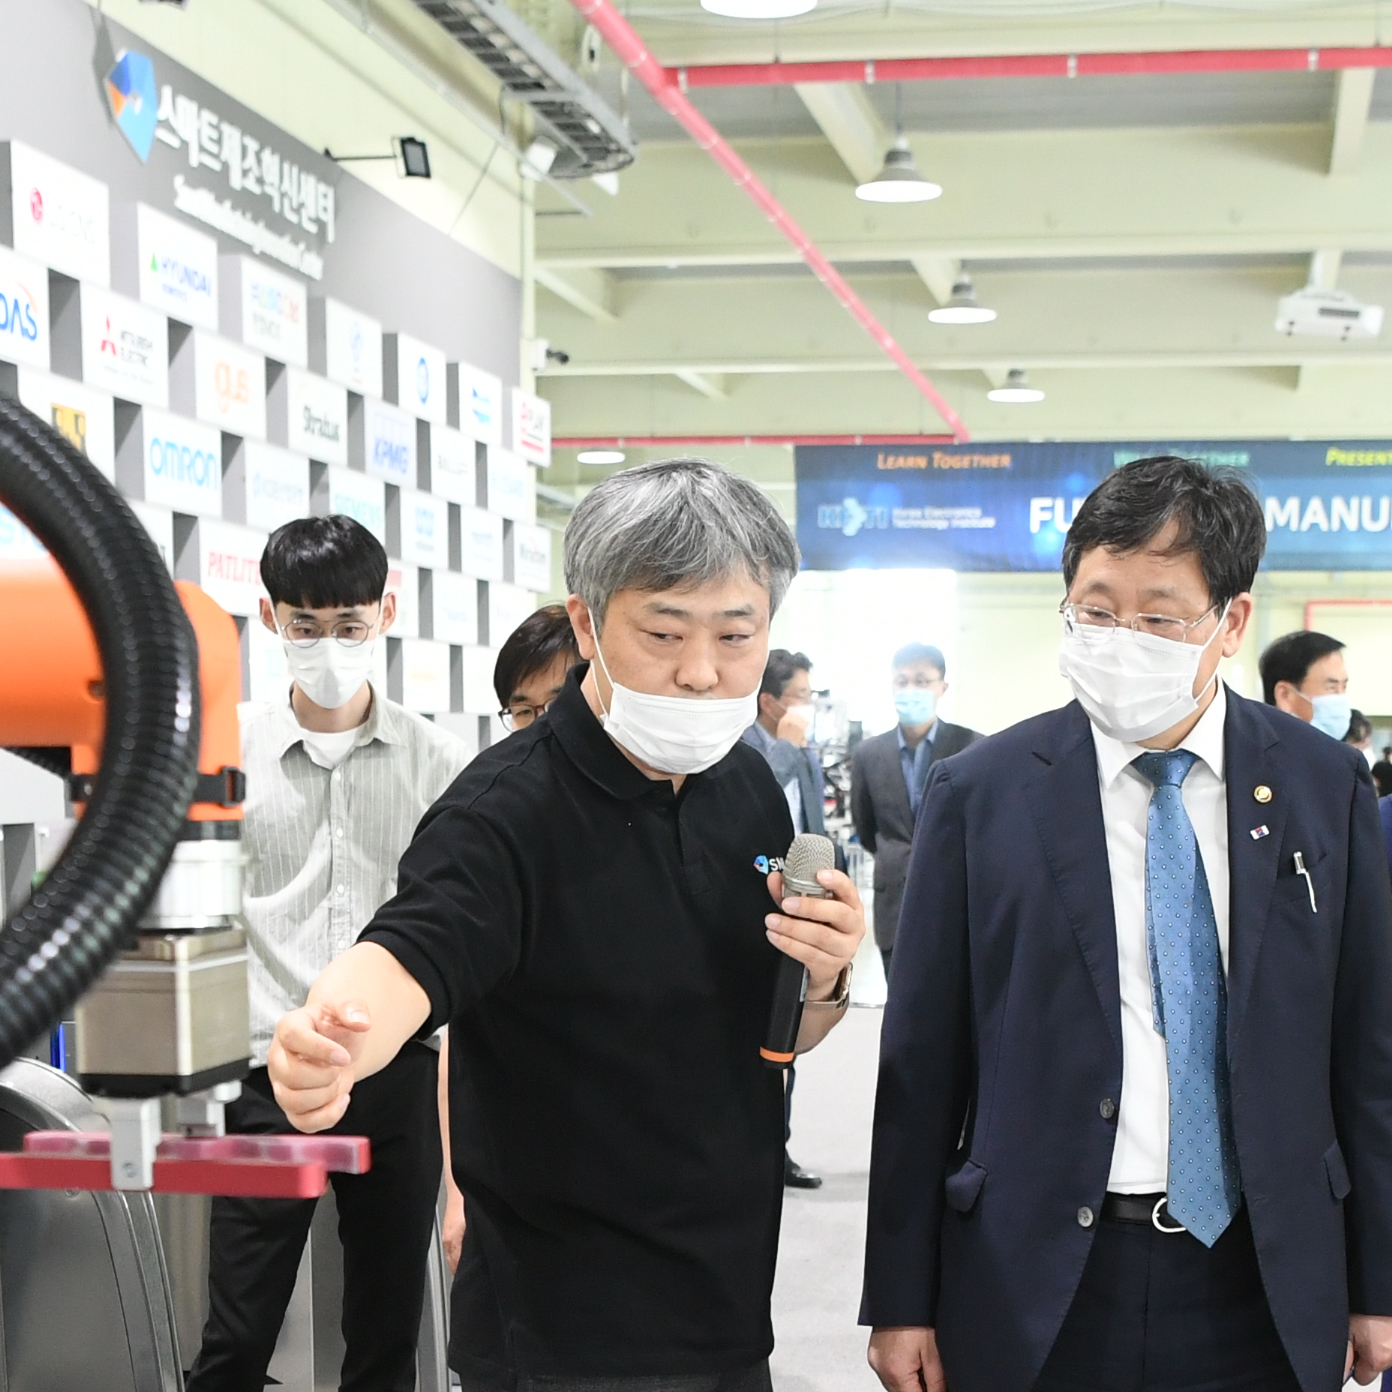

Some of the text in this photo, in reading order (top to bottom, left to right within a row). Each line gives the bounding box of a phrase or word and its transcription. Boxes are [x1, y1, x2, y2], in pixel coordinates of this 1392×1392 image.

[161, 255, 211, 297] HYUNDAI
[150, 437, 218, 492] OMRON
[373, 436, 409, 475] KPMG
